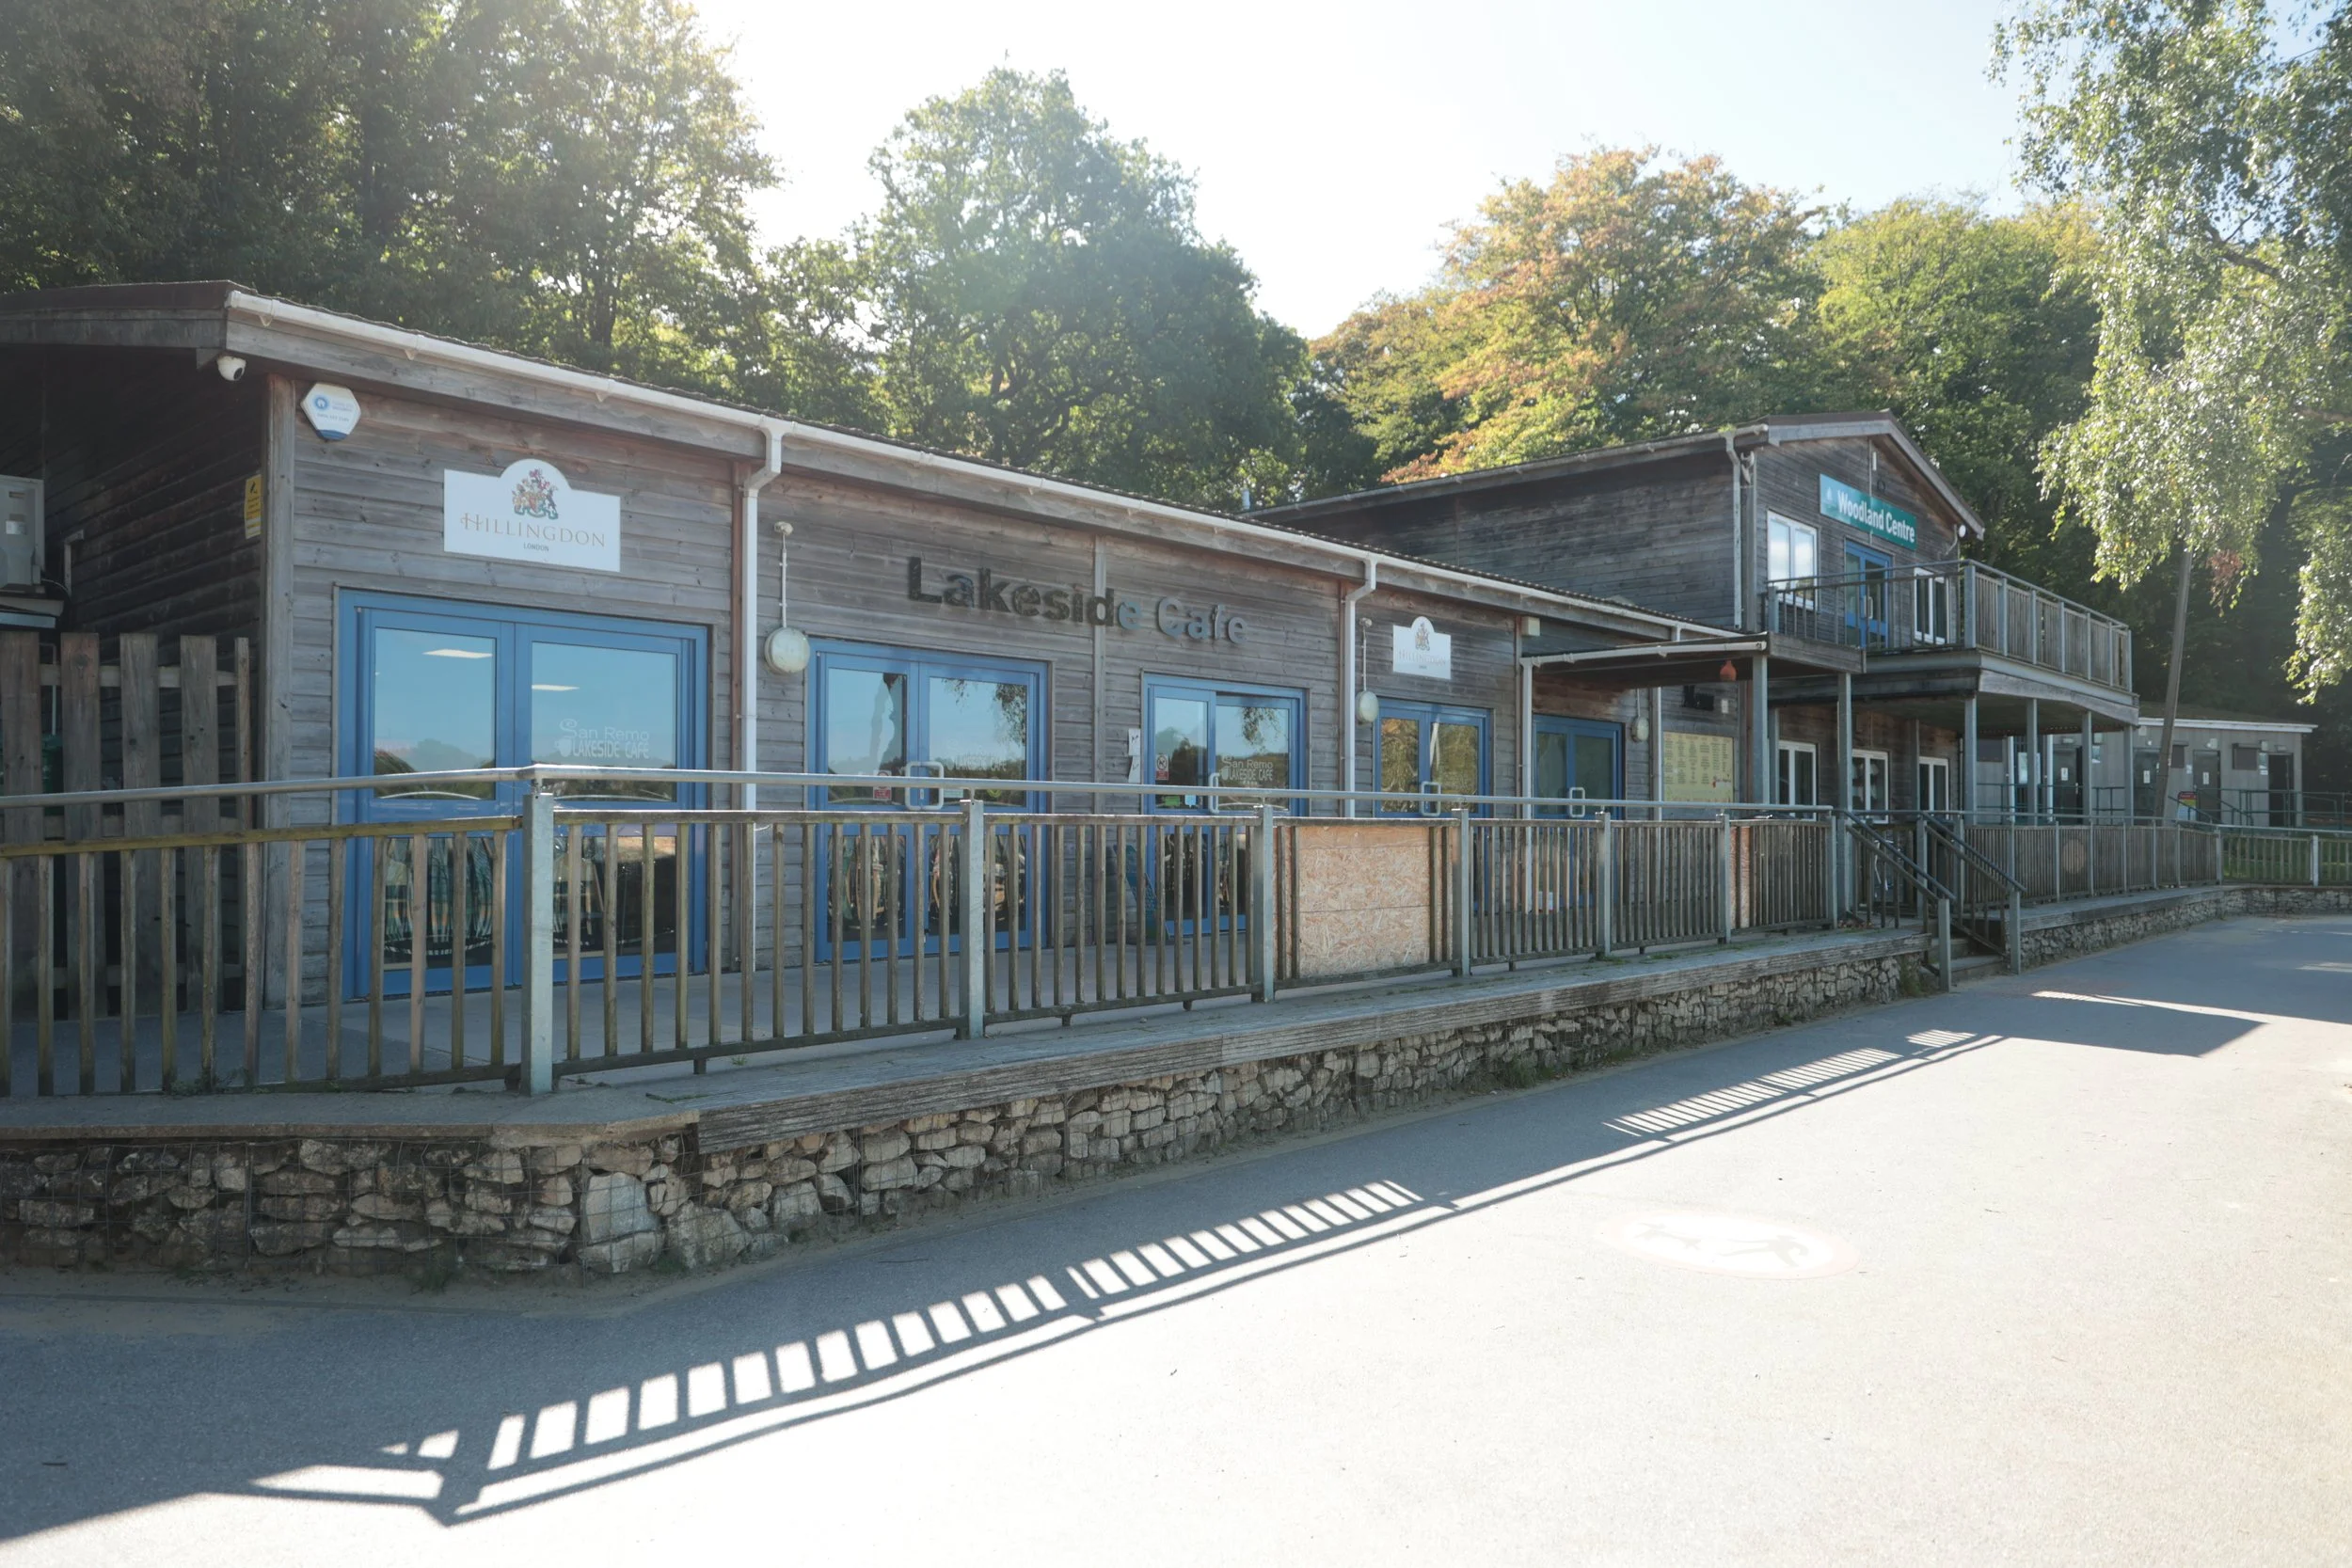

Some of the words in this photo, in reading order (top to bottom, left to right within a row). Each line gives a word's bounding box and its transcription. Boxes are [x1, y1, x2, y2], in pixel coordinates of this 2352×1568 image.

[1837, 489, 1884, 531] Woodland
[1885, 511, 1915, 544] Centre
[460, 513, 605, 547] HILLINGDON
[523, 542, 549, 552] LONDON
[908, 556, 1144, 631] Lakeside
[1155, 595, 1248, 644] Cafe
[559, 718, 598, 739] San
[604, 725, 650, 741] Remo
[572, 739, 621, 758] LAKESIDE
[1221, 754, 1244, 768] San
[1247, 759, 1274, 769] Remo
[1229, 768, 1257, 781] LAKESIDE
